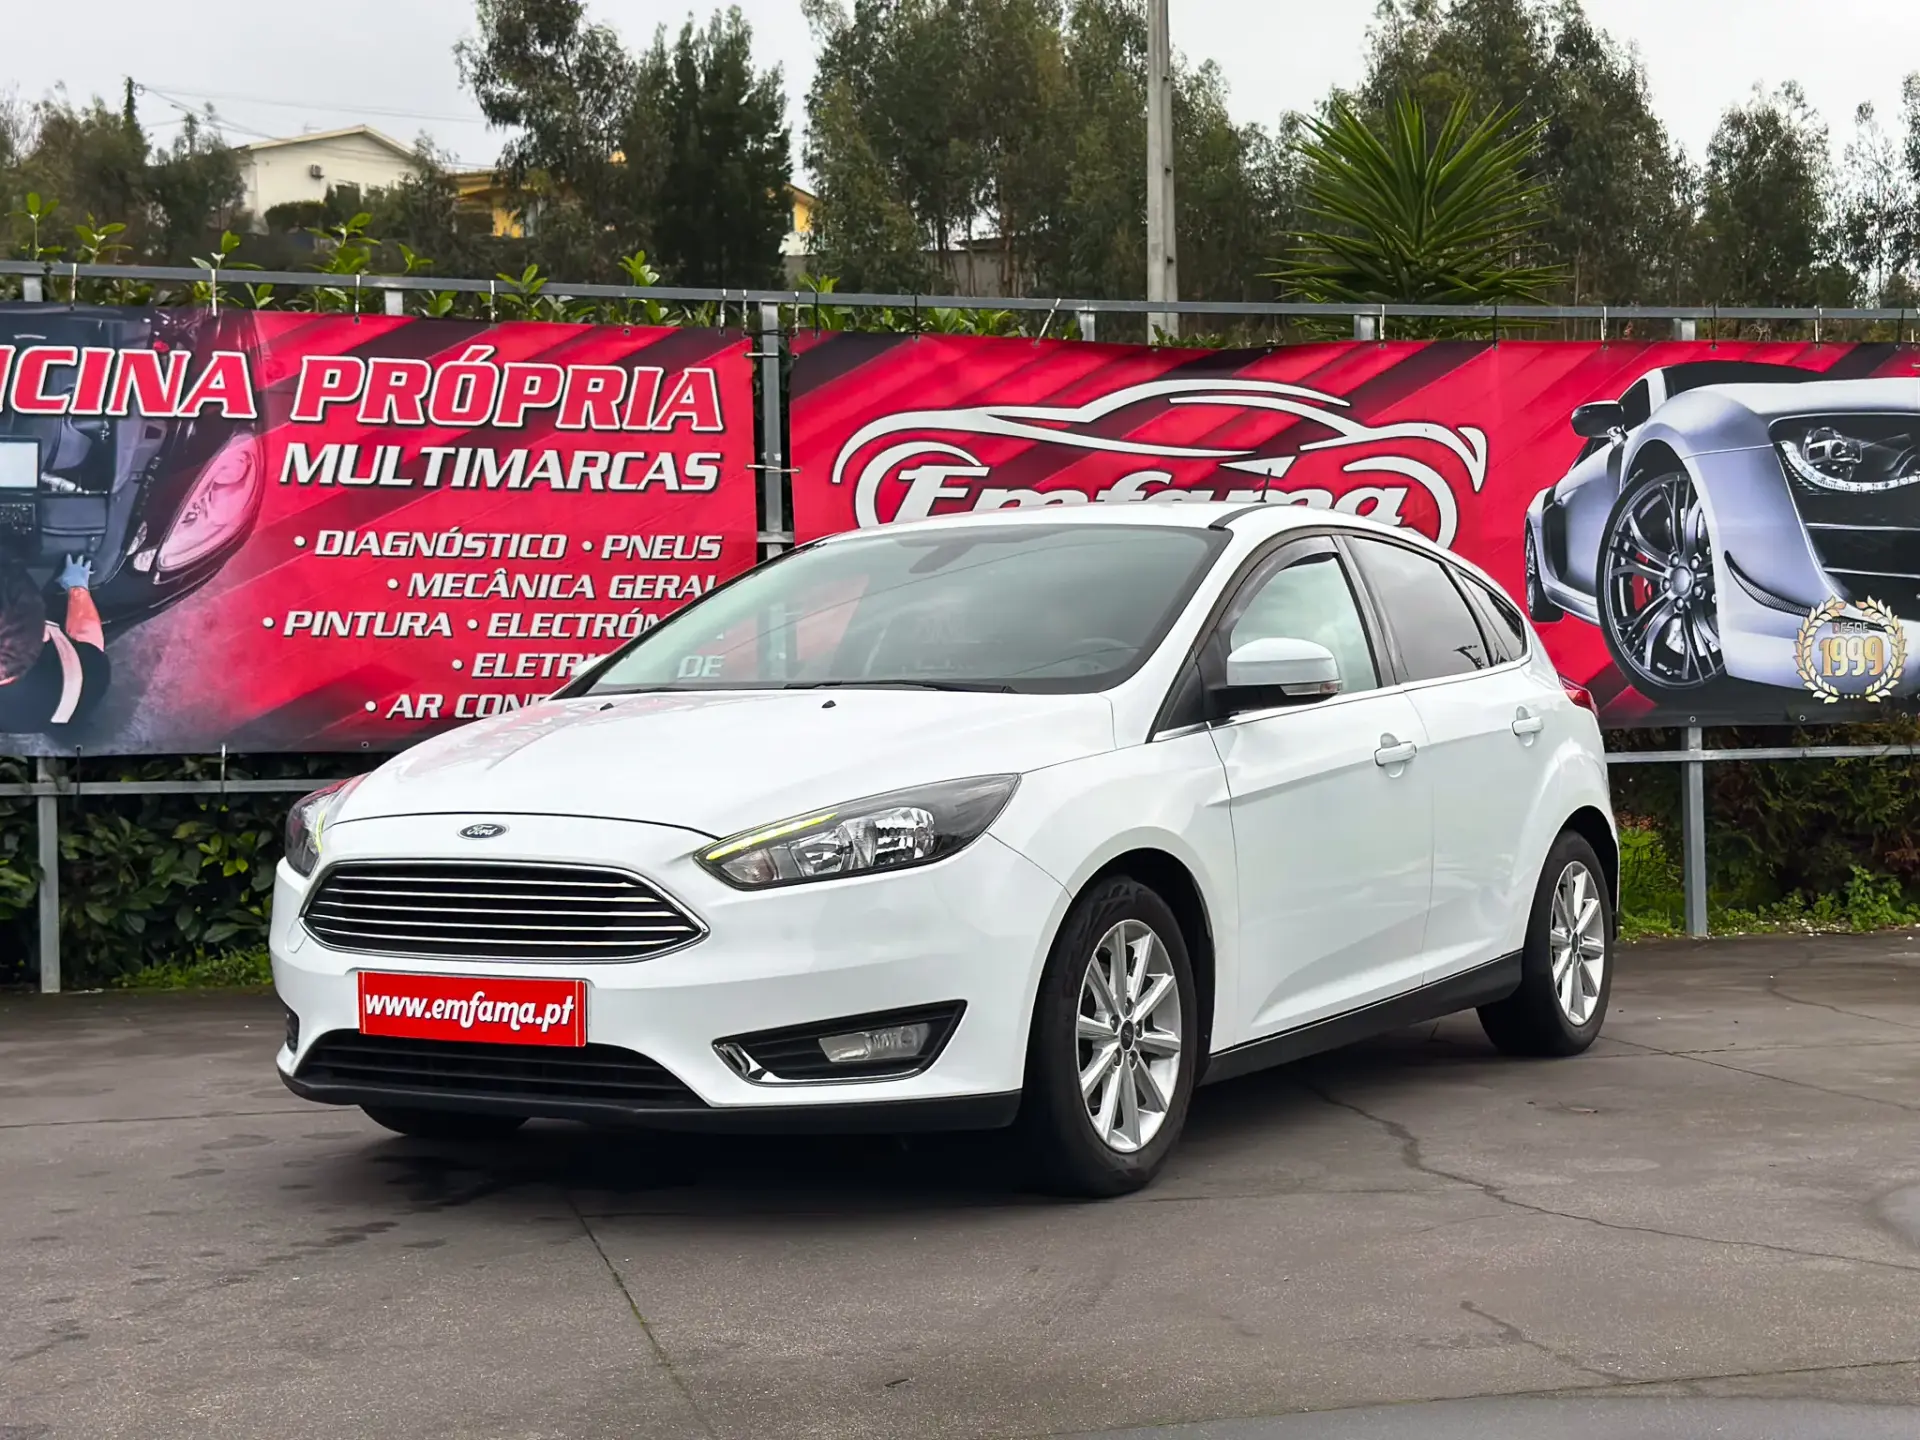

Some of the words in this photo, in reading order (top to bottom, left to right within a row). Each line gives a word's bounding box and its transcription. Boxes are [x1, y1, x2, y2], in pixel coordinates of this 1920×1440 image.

[0, 345, 257, 419] CINA
[291, 345, 723, 432] PRÓPRIA
[280, 443, 720, 491] MULTIMARCAS
[315, 527, 567, 559] DIAGNÓSTICO
[601, 535, 722, 560] PNEUS
[407, 567, 594, 599] MECÂNICA
[283, 611, 452, 637] PINTURA
[1819, 636, 1884, 677] 1999
[385, 694, 445, 720] AR
[466, 825, 499, 836] Ford
[365, 991, 574, 1033] www.emfama.pt
